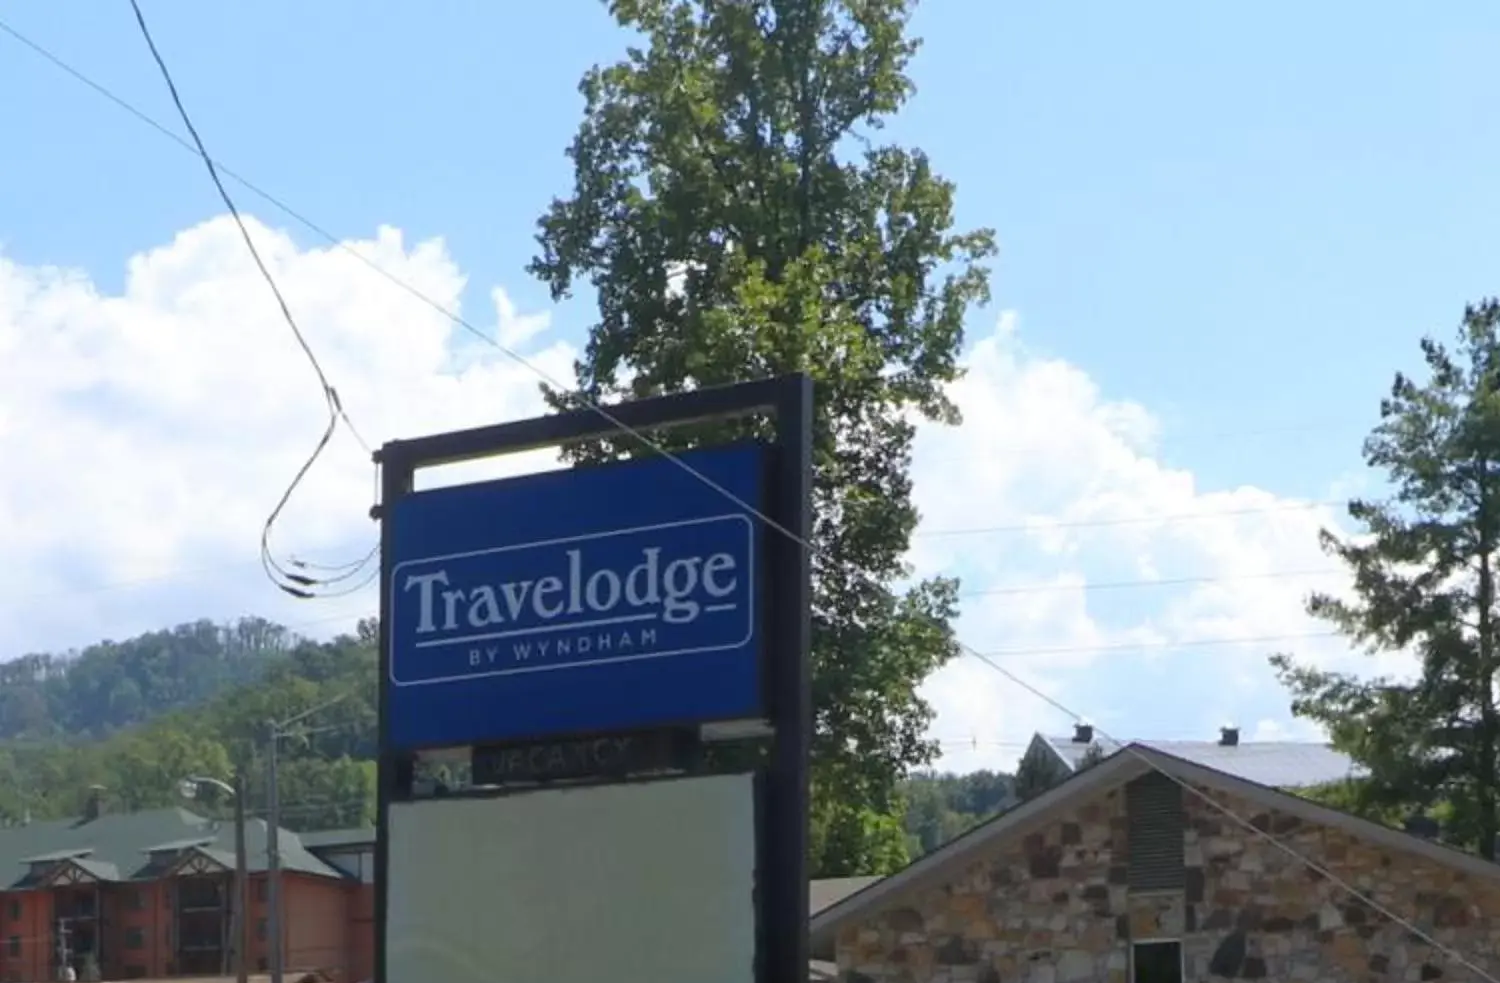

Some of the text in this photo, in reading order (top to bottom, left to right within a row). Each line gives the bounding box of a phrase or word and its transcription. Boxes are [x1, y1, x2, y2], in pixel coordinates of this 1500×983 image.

[404, 547, 737, 633] Travelodge
[469, 629, 657, 666] BY WYNDHAM
